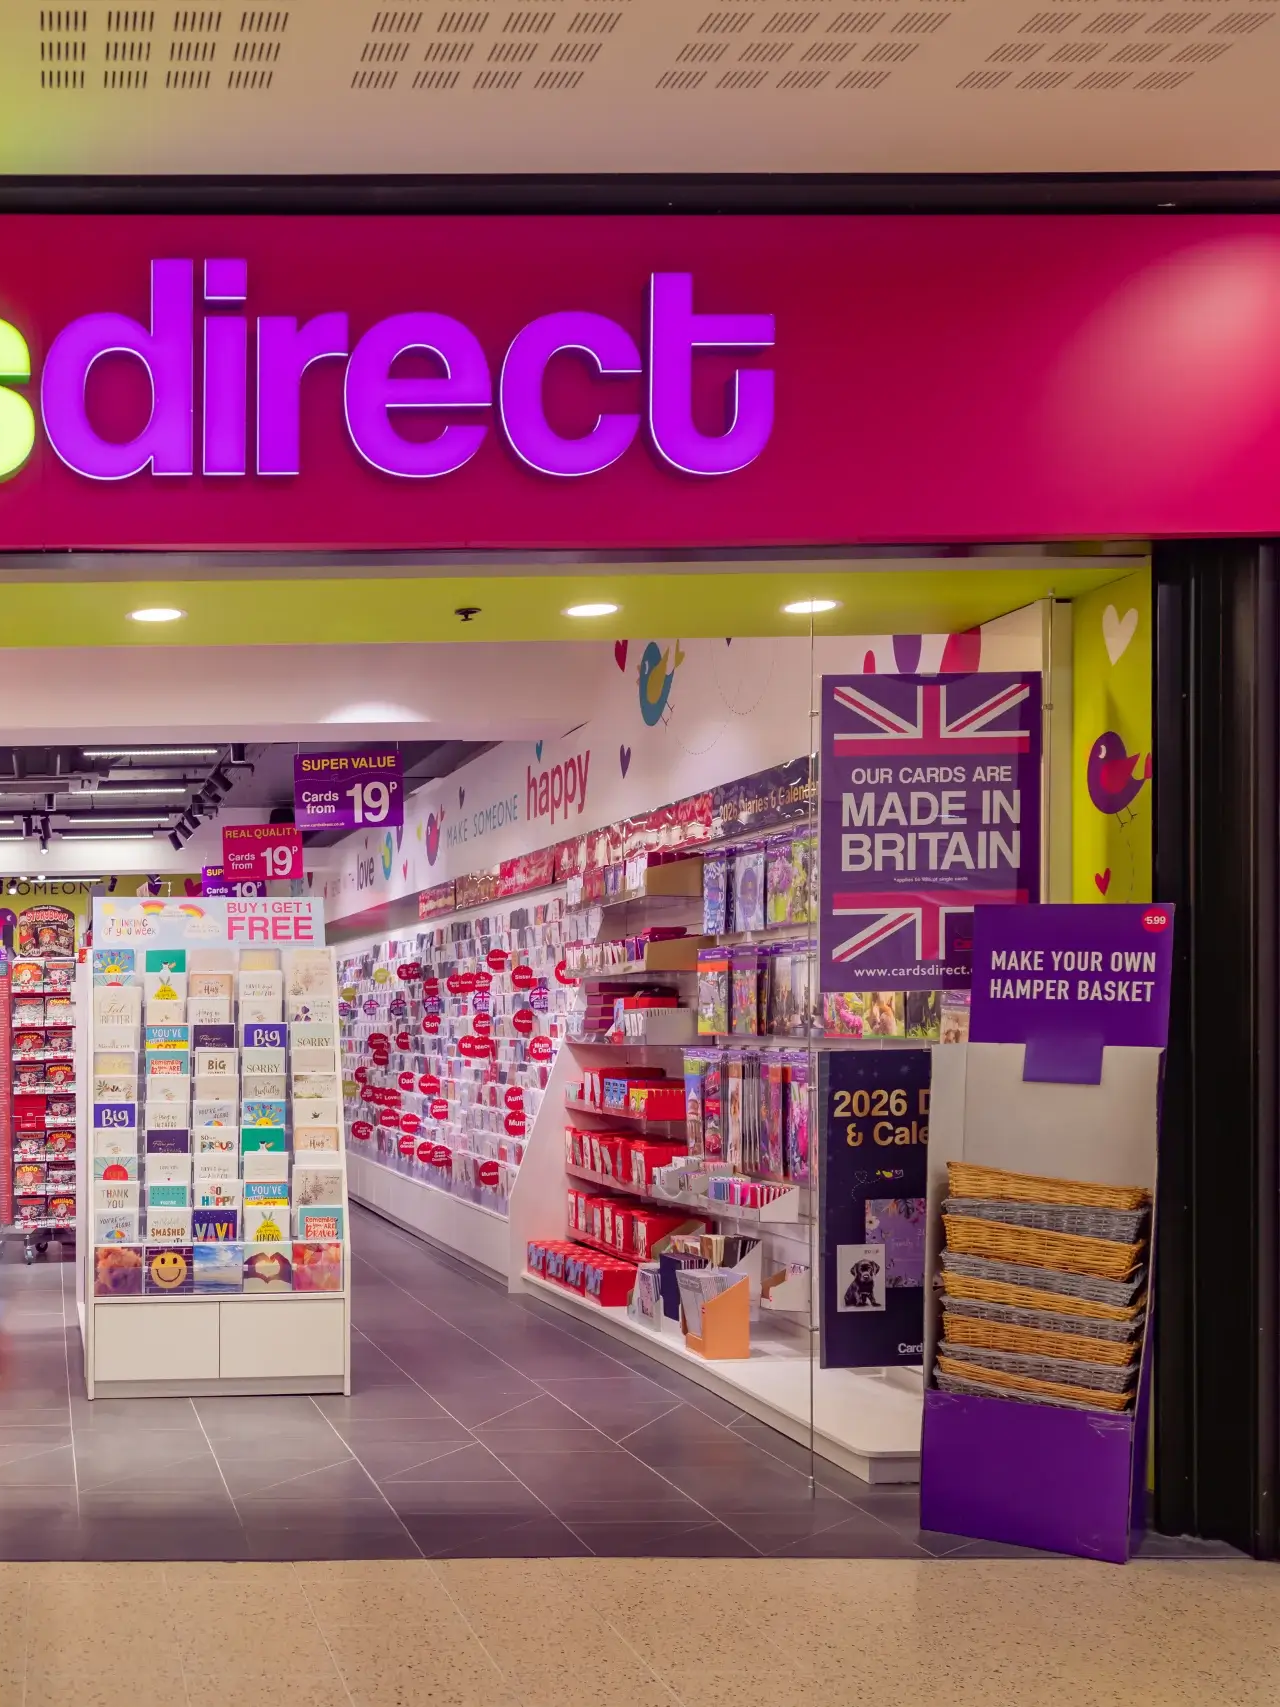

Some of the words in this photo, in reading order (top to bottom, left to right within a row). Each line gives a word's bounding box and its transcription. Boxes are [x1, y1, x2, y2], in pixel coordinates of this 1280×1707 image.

[301, 757, 349, 772] SUPER
[351, 755, 396, 769] VALUE
[851, 768, 893, 785] OUR
[899, 766, 966, 784] CARDS
[972, 765, 1012, 782] ARE
[526, 750, 590, 825] happy
[302, 791, 339, 803] Cards
[306, 803, 336, 815] from
[841, 790, 967, 827] MADE
[982, 789, 1021, 825] IN
[446, 818, 468, 848] MAKE
[473, 794, 518, 839] SOMEONE
[225, 829, 254, 839] REAL
[254, 827, 299, 839] QUALITY
[228, 852, 255, 862] Cards
[841, 830, 1021, 872] BRITAIN
[206, 868, 224, 876] SUP
[231, 861, 253, 870] from
[356, 854, 375, 891] love
[227, 902, 259, 914] BUY
[262, 902, 267, 913] 1
[271, 902, 303, 913] GET
[306, 902, 312, 913] 1
[227, 916, 314, 941] FREE
[991, 950, 1045, 971] MAKE
[1051, 951, 1103, 972] YOUR
[1110, 952, 1156, 973] OWN
[990, 979, 1069, 1000] HAMPER
[1077, 980, 1155, 1002] BASKET
[253, 1028, 281, 1048] Big
[297, 1037, 330, 1047] SORRY
[246, 1063, 280, 1073] SORRY
[833, 1088, 908, 1118] 2026
[101, 1108, 129, 1128] Big
[846, 1122, 863, 1147] &
[101, 1189, 129, 1198] THANK
[210, 1186, 222, 1195] SO
[107, 1200, 124, 1209] YOU
[201, 1196, 235, 1207] HAPPY
[150, 1227, 186, 1237] SMASHED
